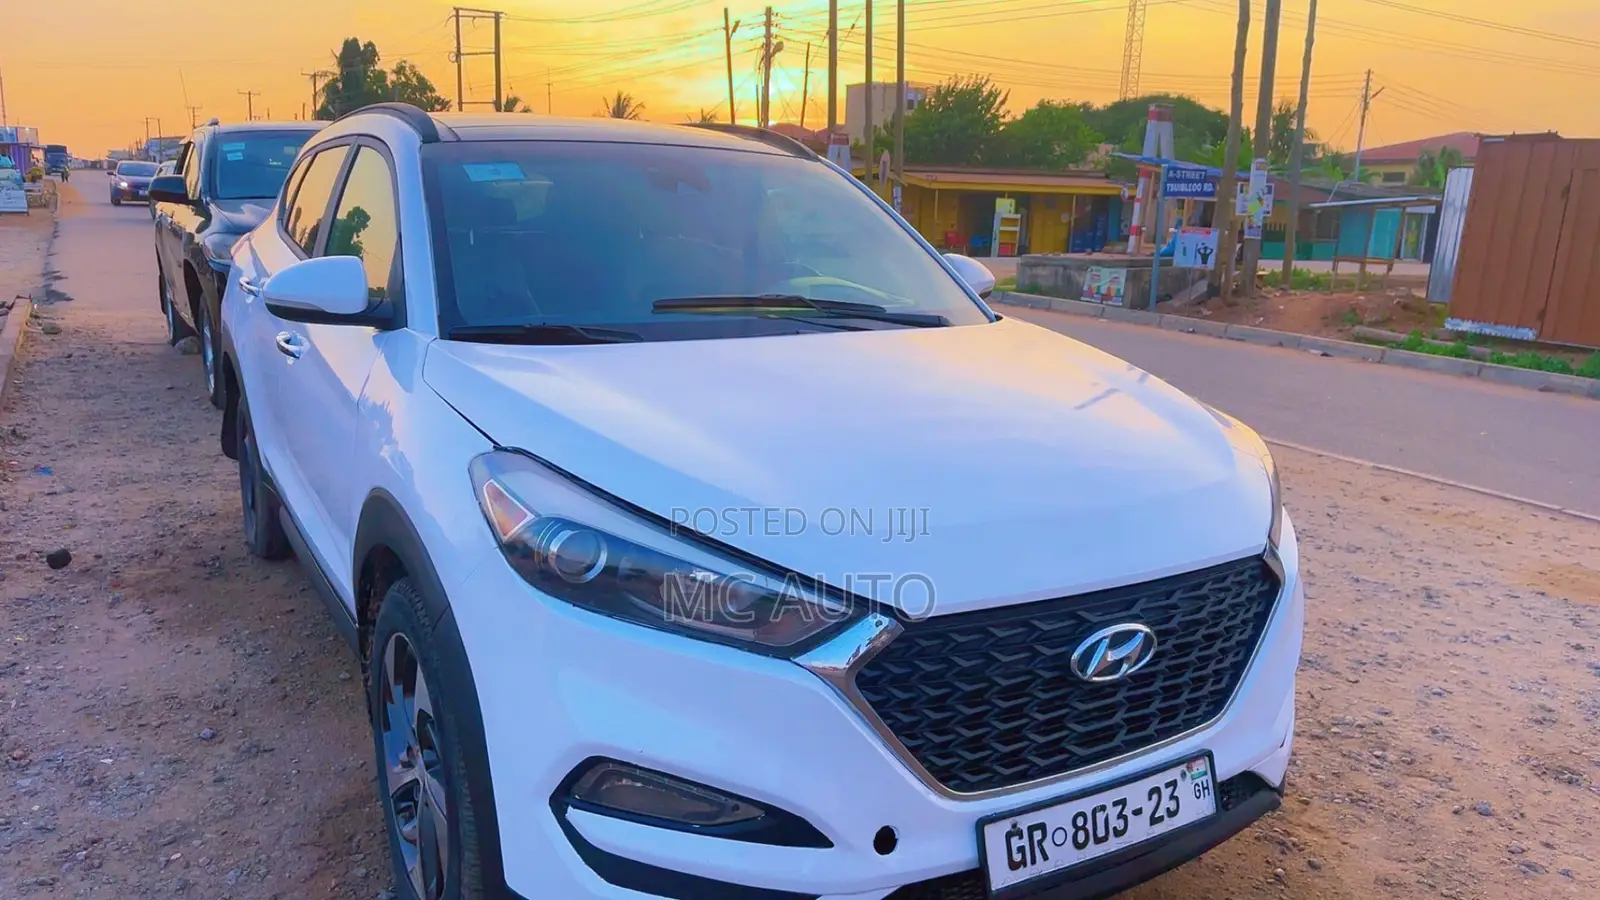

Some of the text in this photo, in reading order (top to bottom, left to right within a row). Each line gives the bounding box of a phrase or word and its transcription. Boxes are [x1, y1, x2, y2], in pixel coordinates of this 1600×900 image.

[1168, 170, 1206, 180] A-STREET
[1193, 779, 1211, 800] GH
[1004, 778, 1181, 872] GR 803-23
